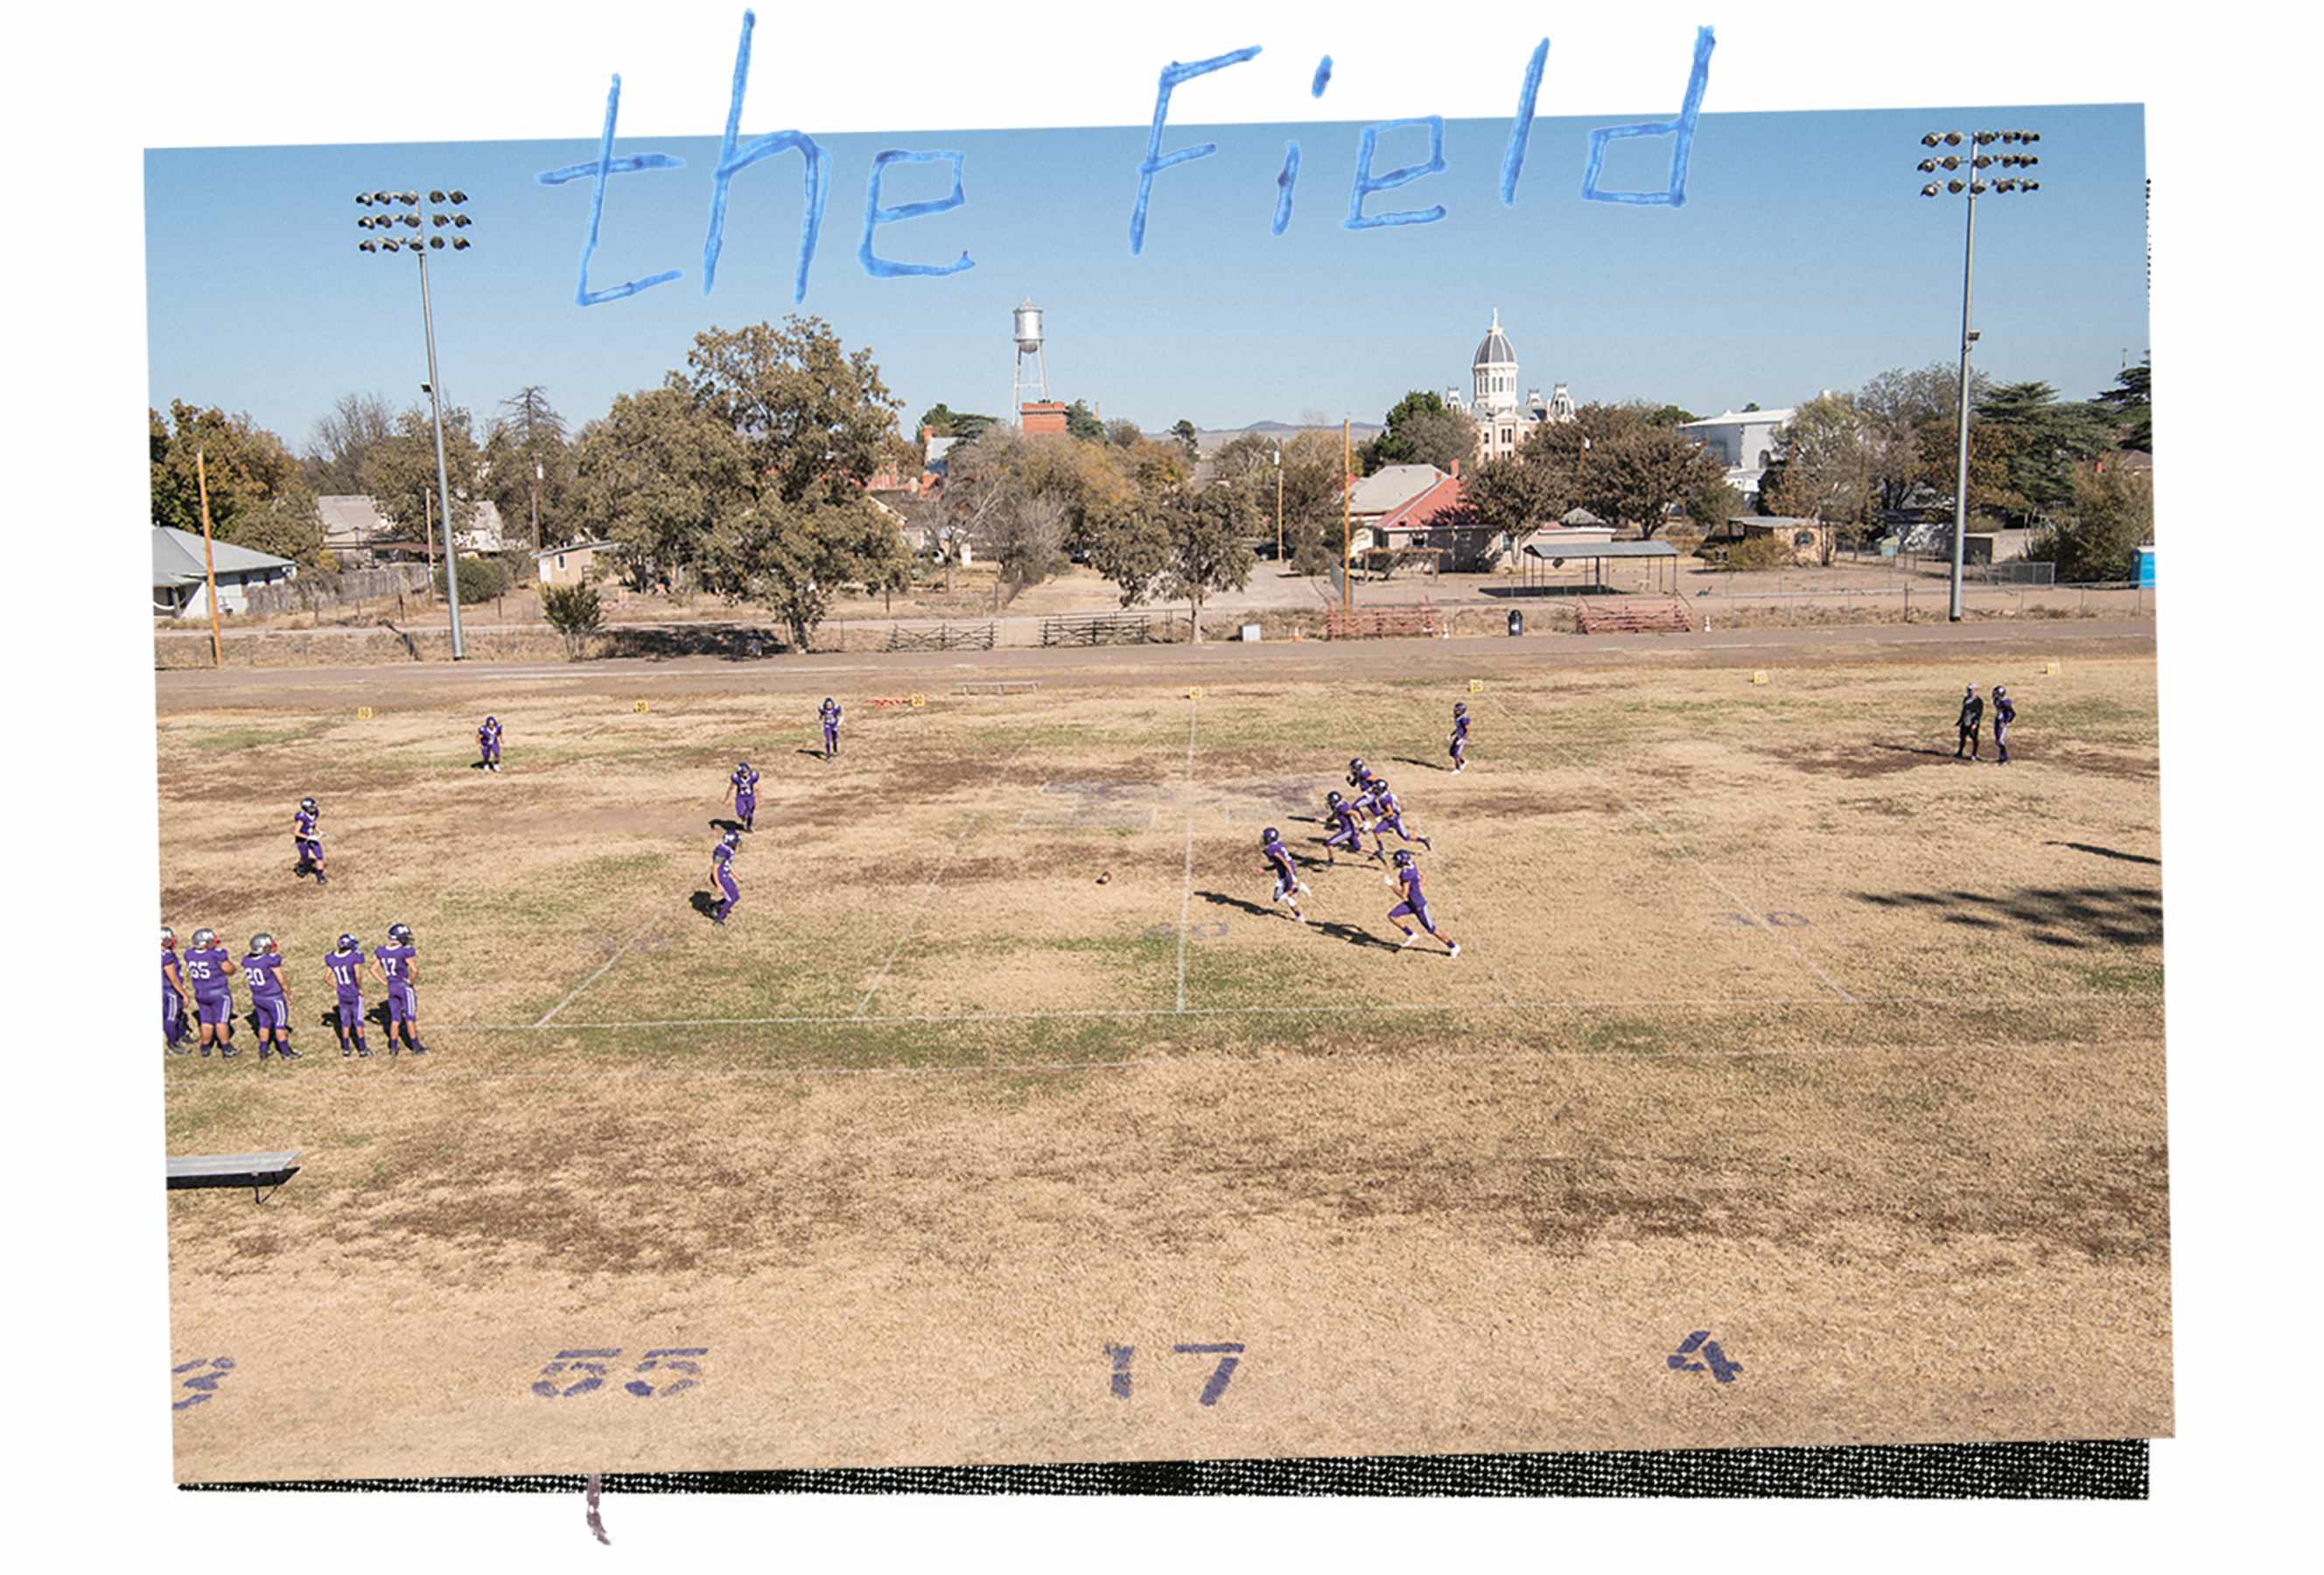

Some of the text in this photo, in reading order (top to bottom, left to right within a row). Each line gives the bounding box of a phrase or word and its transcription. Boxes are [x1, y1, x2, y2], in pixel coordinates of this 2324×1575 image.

[188, 960, 211, 980] 65
[333, 965, 351, 985] 11
[381, 957, 397, 976] 17
[244, 967, 266, 987] 20
[1666, 1329, 1744, 1384] 4
[531, 1348, 708, 1399] 55
[1102, 1343, 1246, 1406] 17
